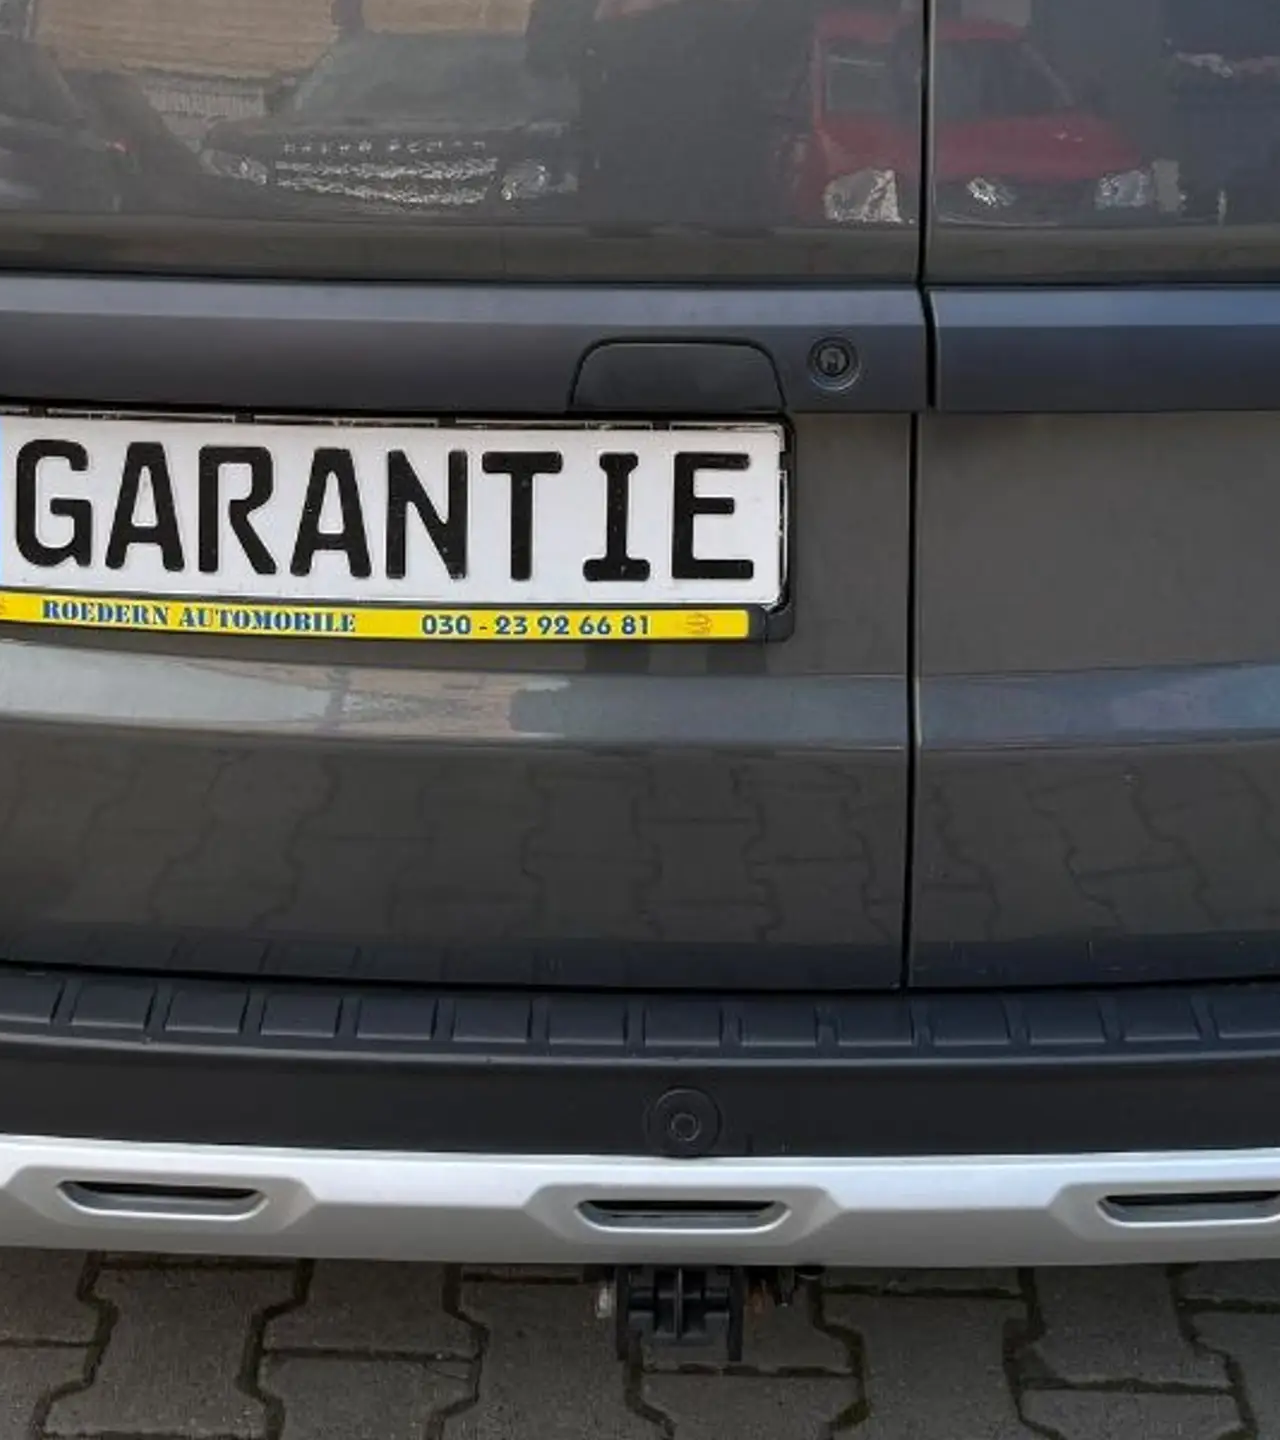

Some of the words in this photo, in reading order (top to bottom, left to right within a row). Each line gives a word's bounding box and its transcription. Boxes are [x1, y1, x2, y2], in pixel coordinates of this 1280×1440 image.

[15, 438, 755, 581] GARANTIE
[41, 599, 170, 626] ROEDERN
[178, 606, 357, 633] AUTOMOBILE
[421, 613, 471, 635] 030
[495, 614, 528, 635] 23
[537, 614, 570, 635] 92
[578, 614, 612, 635] 66
[620, 614, 650, 635] 81
